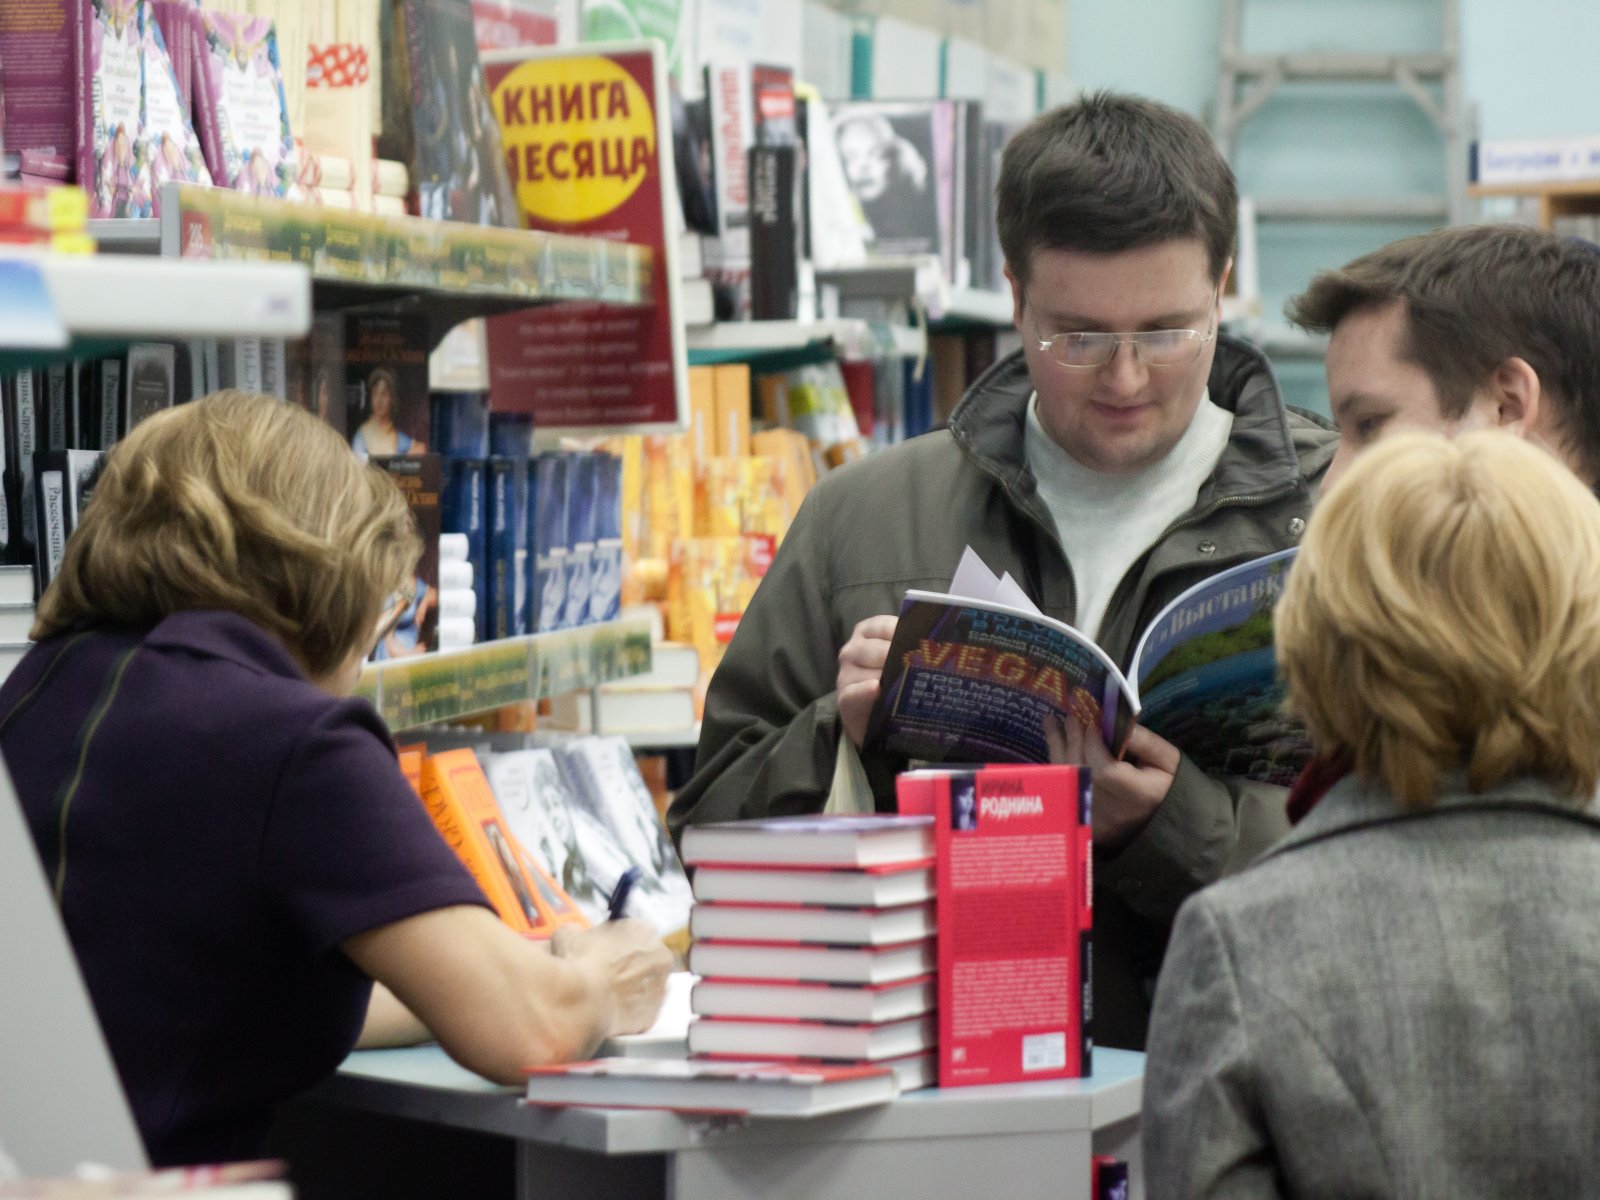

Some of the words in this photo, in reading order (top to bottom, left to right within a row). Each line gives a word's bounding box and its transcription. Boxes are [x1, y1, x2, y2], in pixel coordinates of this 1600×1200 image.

[503, 80, 630, 125] КНИГА
[49, 487, 62, 560] Рассечение
[1171, 572, 1283, 636] Выставк
[918, 638, 1103, 729] VEGAS
[981, 795, 1044, 820] РОДНИНА
